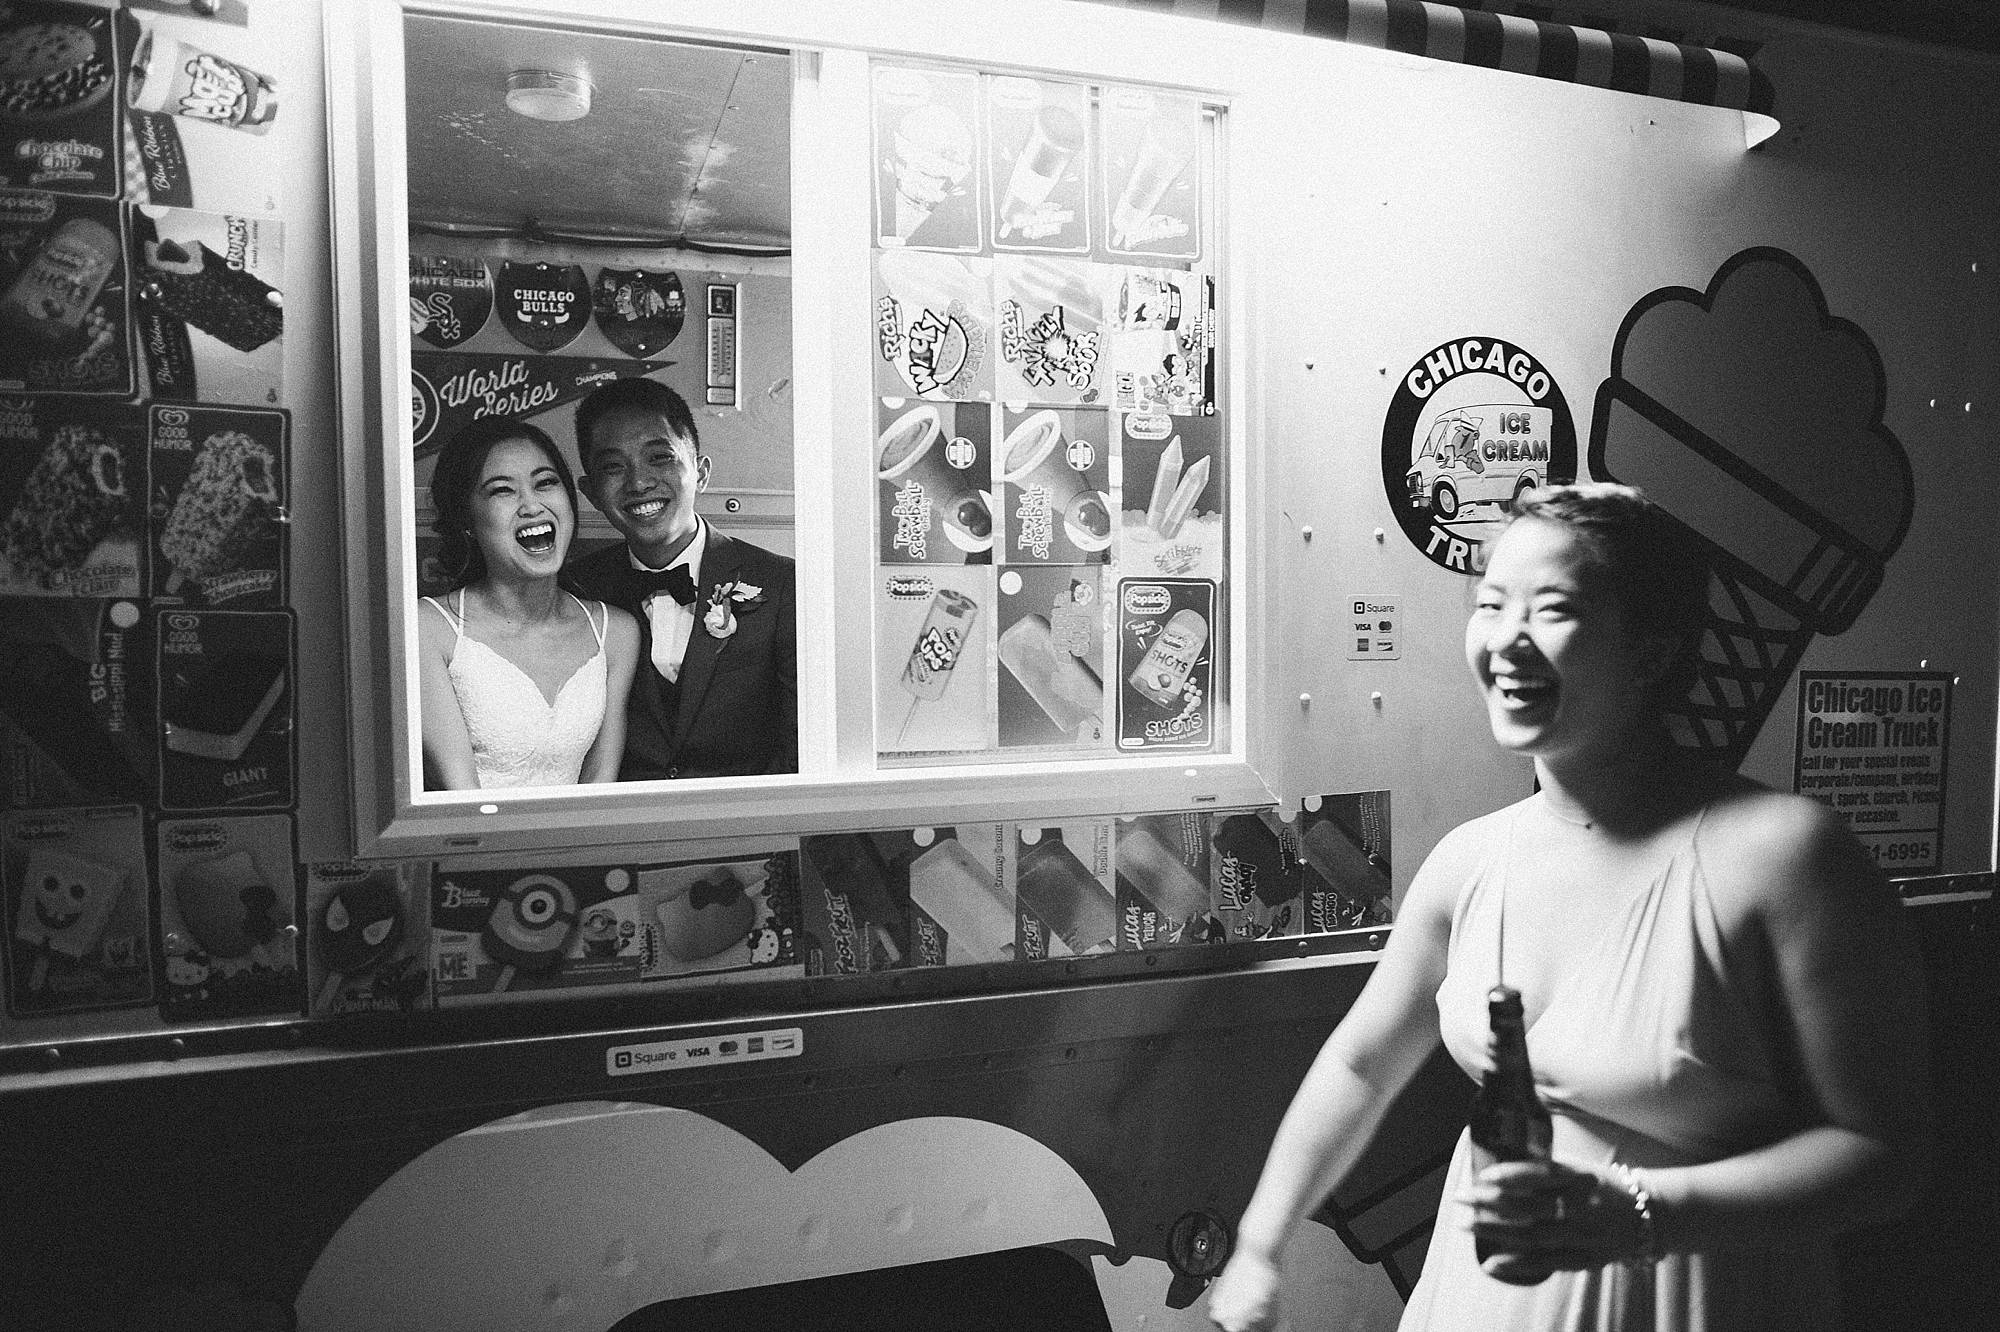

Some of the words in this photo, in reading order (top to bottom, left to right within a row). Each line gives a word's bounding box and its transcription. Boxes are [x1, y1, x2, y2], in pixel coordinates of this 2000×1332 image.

[143, 116, 162, 160] Ribbon
[152, 162, 172, 191] Blue
[224, 214, 248, 271] CRUNCH
[452, 278, 486, 288] SOX
[513, 289, 575, 303] CHICAGO
[522, 301, 565, 313] BULLS
[150, 315, 167, 355] Ribbon
[908, 308, 949, 396] WACKY
[156, 358, 174, 385] Blue
[439, 360, 530, 407] World
[1406, 340, 1551, 400] CHICAGO
[473, 381, 559, 421] Series
[158, 426, 189, 439] GOOD
[1499, 413, 1532, 436] ICE
[153, 439, 193, 451] HUMOR
[1481, 440, 1550, 462] CREAM
[892, 490, 910, 518] Ball
[1016, 494, 1035, 519] Ball
[893, 519, 913, 550] Two
[906, 482, 926, 560] Screwball
[1031, 485, 1049, 560] Screwball
[1018, 520, 1037, 551] Two
[1424, 525, 1487, 575] TRU
[1366, 603, 1395, 613] Square
[168, 631, 198, 642] GOOD
[1354, 623, 1372, 631] VISA
[105, 633, 125, 659] Mud
[164, 643, 204, 654] HUMOR
[918, 637, 945, 672] UPS
[926, 626, 954, 663] POP
[1151, 649, 1188, 675] SHOTS
[88, 664, 107, 704] BIG
[1808, 682, 1904, 717] Chicago
[1908, 682, 1943, 713] Ice
[1145, 713, 1203, 738] SHOTS
[1808, 717, 1878, 749] Cream
[1882, 717, 1940, 748] Truck
[1801, 756, 1821, 770] call
[1822, 756, 1838, 769] for
[1839, 757, 1863, 770] your
[1864, 755, 1898, 769] special
[222, 767, 268, 787] GIANT
[1219, 850, 1244, 912] Lucas
[1141, 911, 1157, 944] PELUCAS
[439, 953, 470, 979] ME
[634, 1050, 677, 1066] Square
[686, 1048, 711, 1059] VISA
